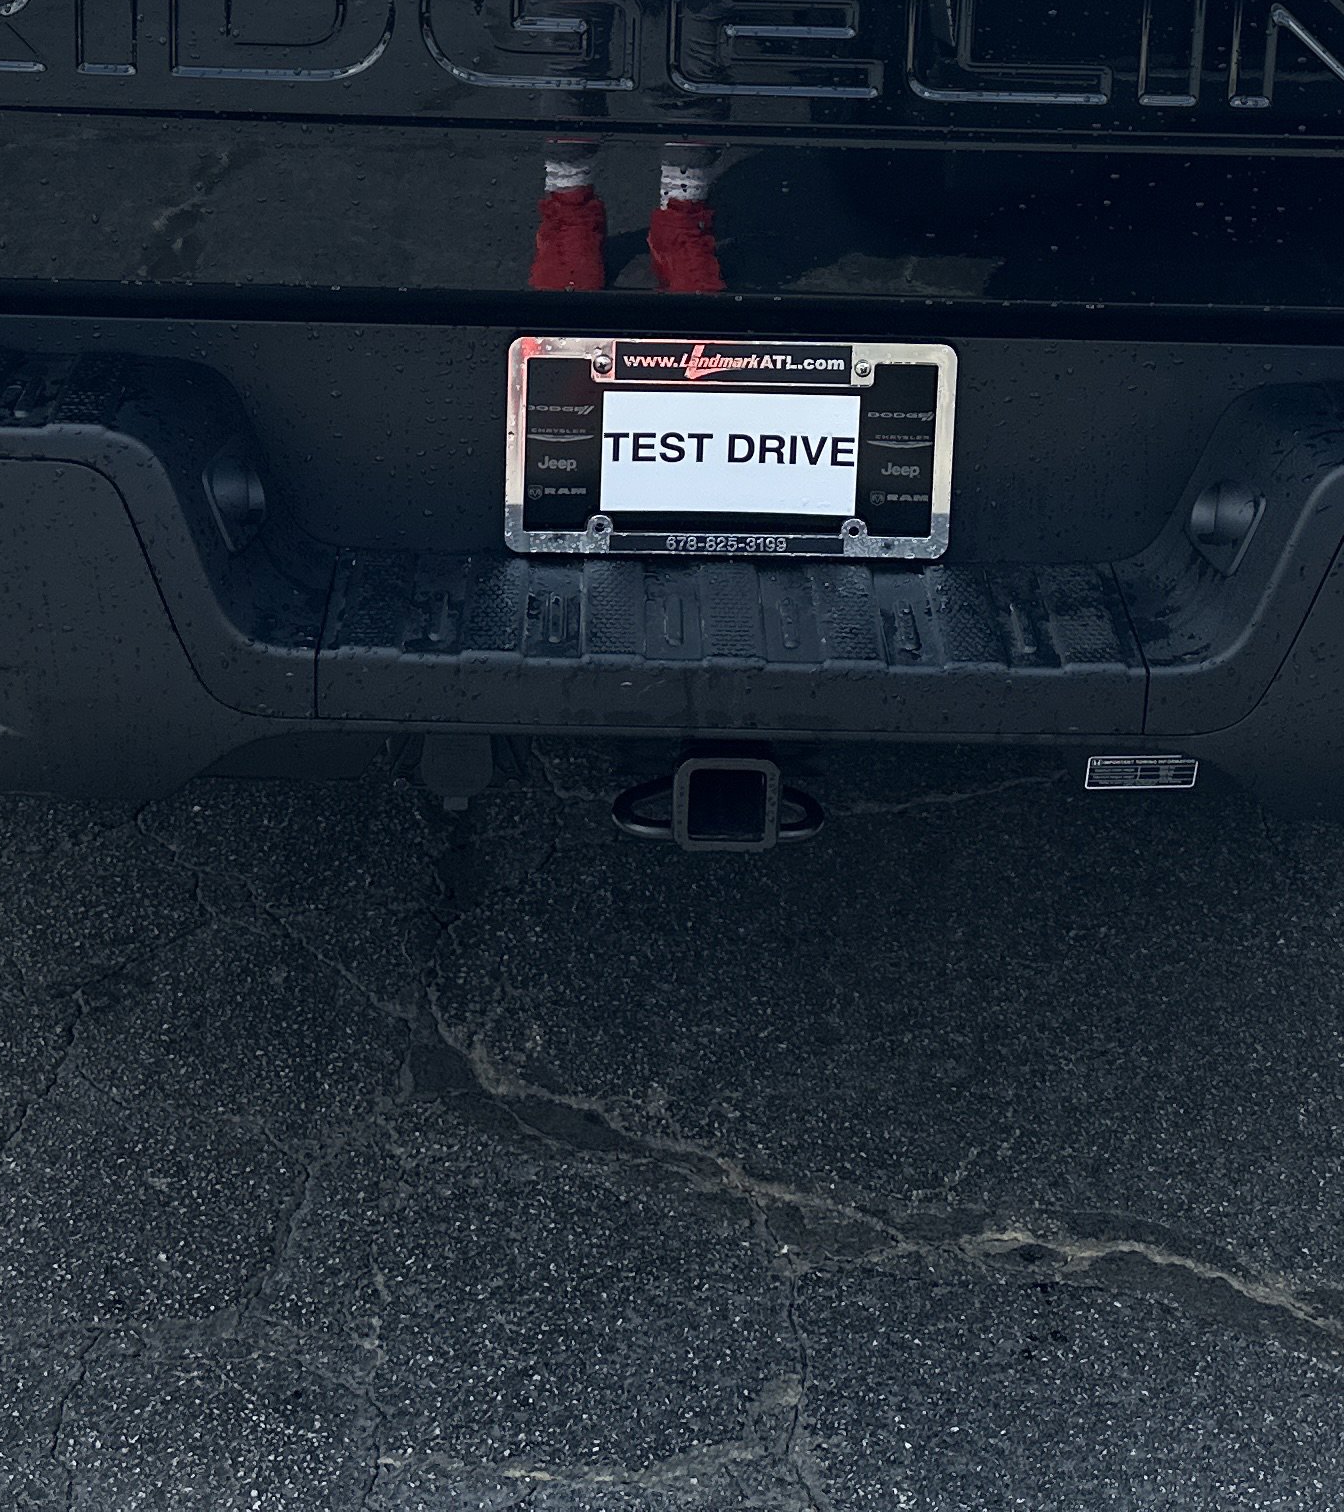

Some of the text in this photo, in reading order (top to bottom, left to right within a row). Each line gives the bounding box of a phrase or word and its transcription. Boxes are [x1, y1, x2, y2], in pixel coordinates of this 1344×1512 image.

[622, 344, 846, 380] www.LandmarkATL.com
[867, 411, 932, 420] DODGE
[603, 431, 856, 467] TEST DRIVE
[537, 455, 578, 472] Jeep
[880, 462, 921, 478] Jeep
[544, 487, 587, 495] RAM
[886, 494, 929, 502] RAM
